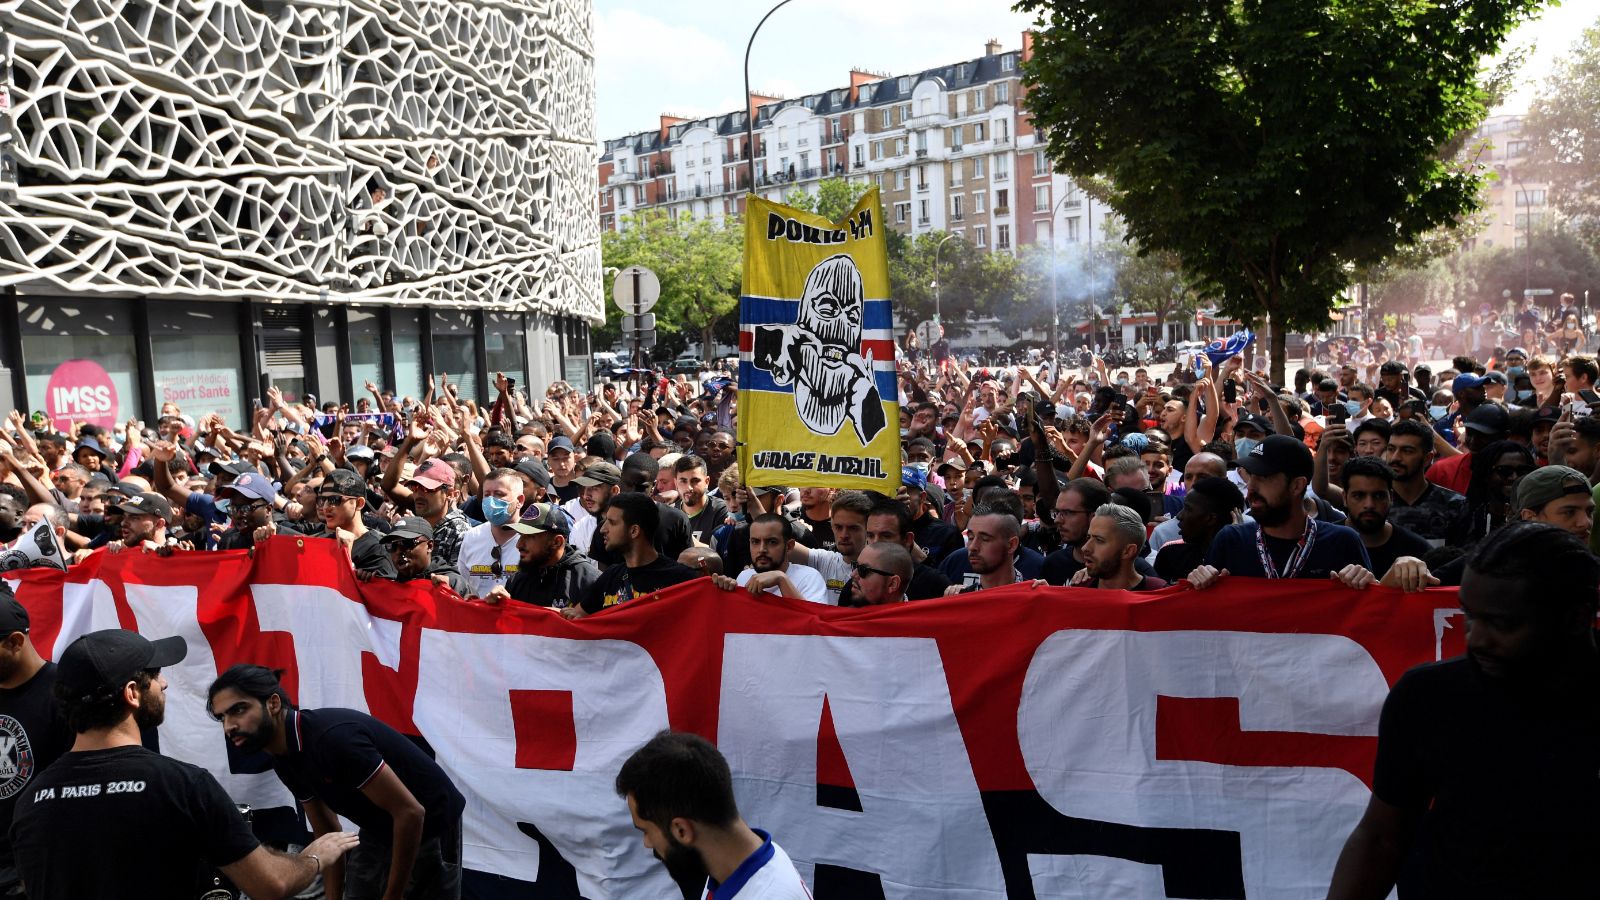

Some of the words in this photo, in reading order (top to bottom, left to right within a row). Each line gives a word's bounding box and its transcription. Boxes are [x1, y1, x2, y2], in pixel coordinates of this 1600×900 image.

[53, 385, 112, 414] IMSS
[163, 386, 196, 402] Sport
[199, 385, 230, 399] Santé
[34, 788, 56, 803] LPA
[61, 784, 101, 798] PARIS
[106, 781, 146, 794] 2010
